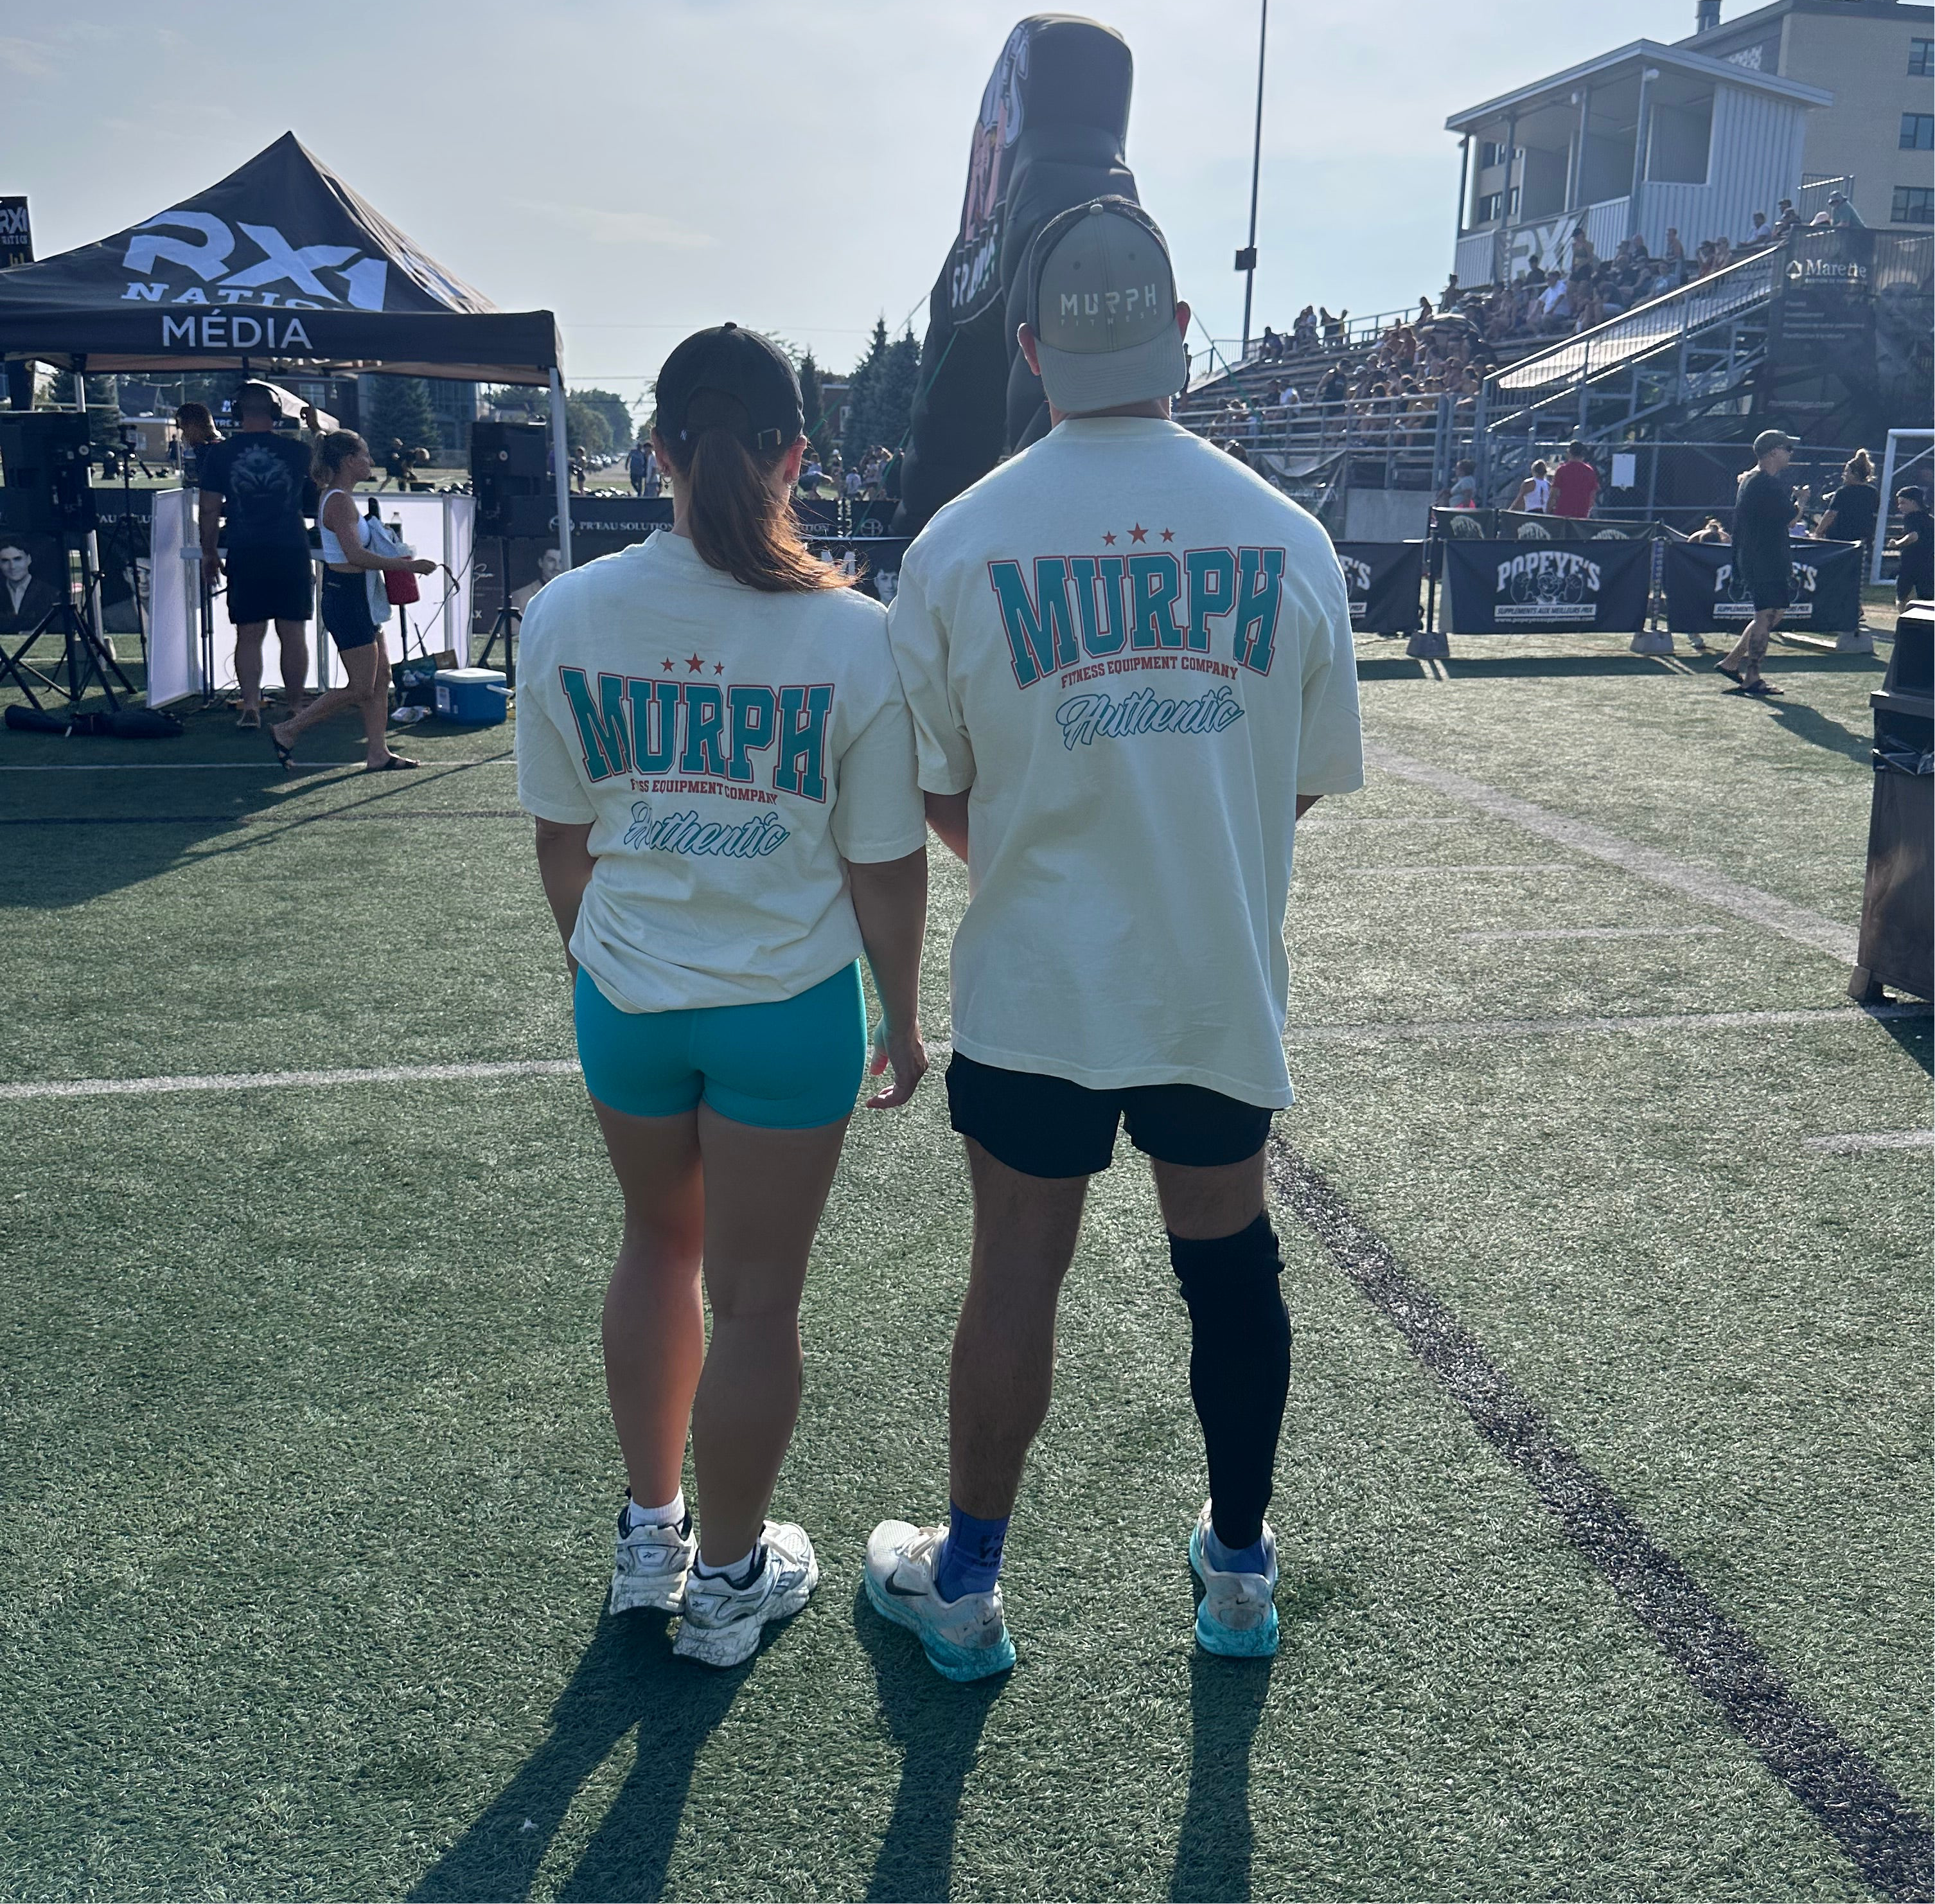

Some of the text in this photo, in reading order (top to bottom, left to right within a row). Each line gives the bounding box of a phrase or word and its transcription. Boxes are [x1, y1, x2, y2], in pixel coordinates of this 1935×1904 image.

[121, 282, 344, 310] NATI
[1060, 283, 1156, 316] MURPH
[163, 308, 314, 350] MÉDIA
[1496, 551, 1601, 593] POPEYE'S
[987, 547, 1286, 690] MURPH
[1061, 656, 1238, 689] FITNESS EQUIPMENT COMPANY
[558, 666, 835, 804] MURPH
[1056, 686, 1245, 751] Authentic
[651, 779, 724, 795] EQUIPMENT
